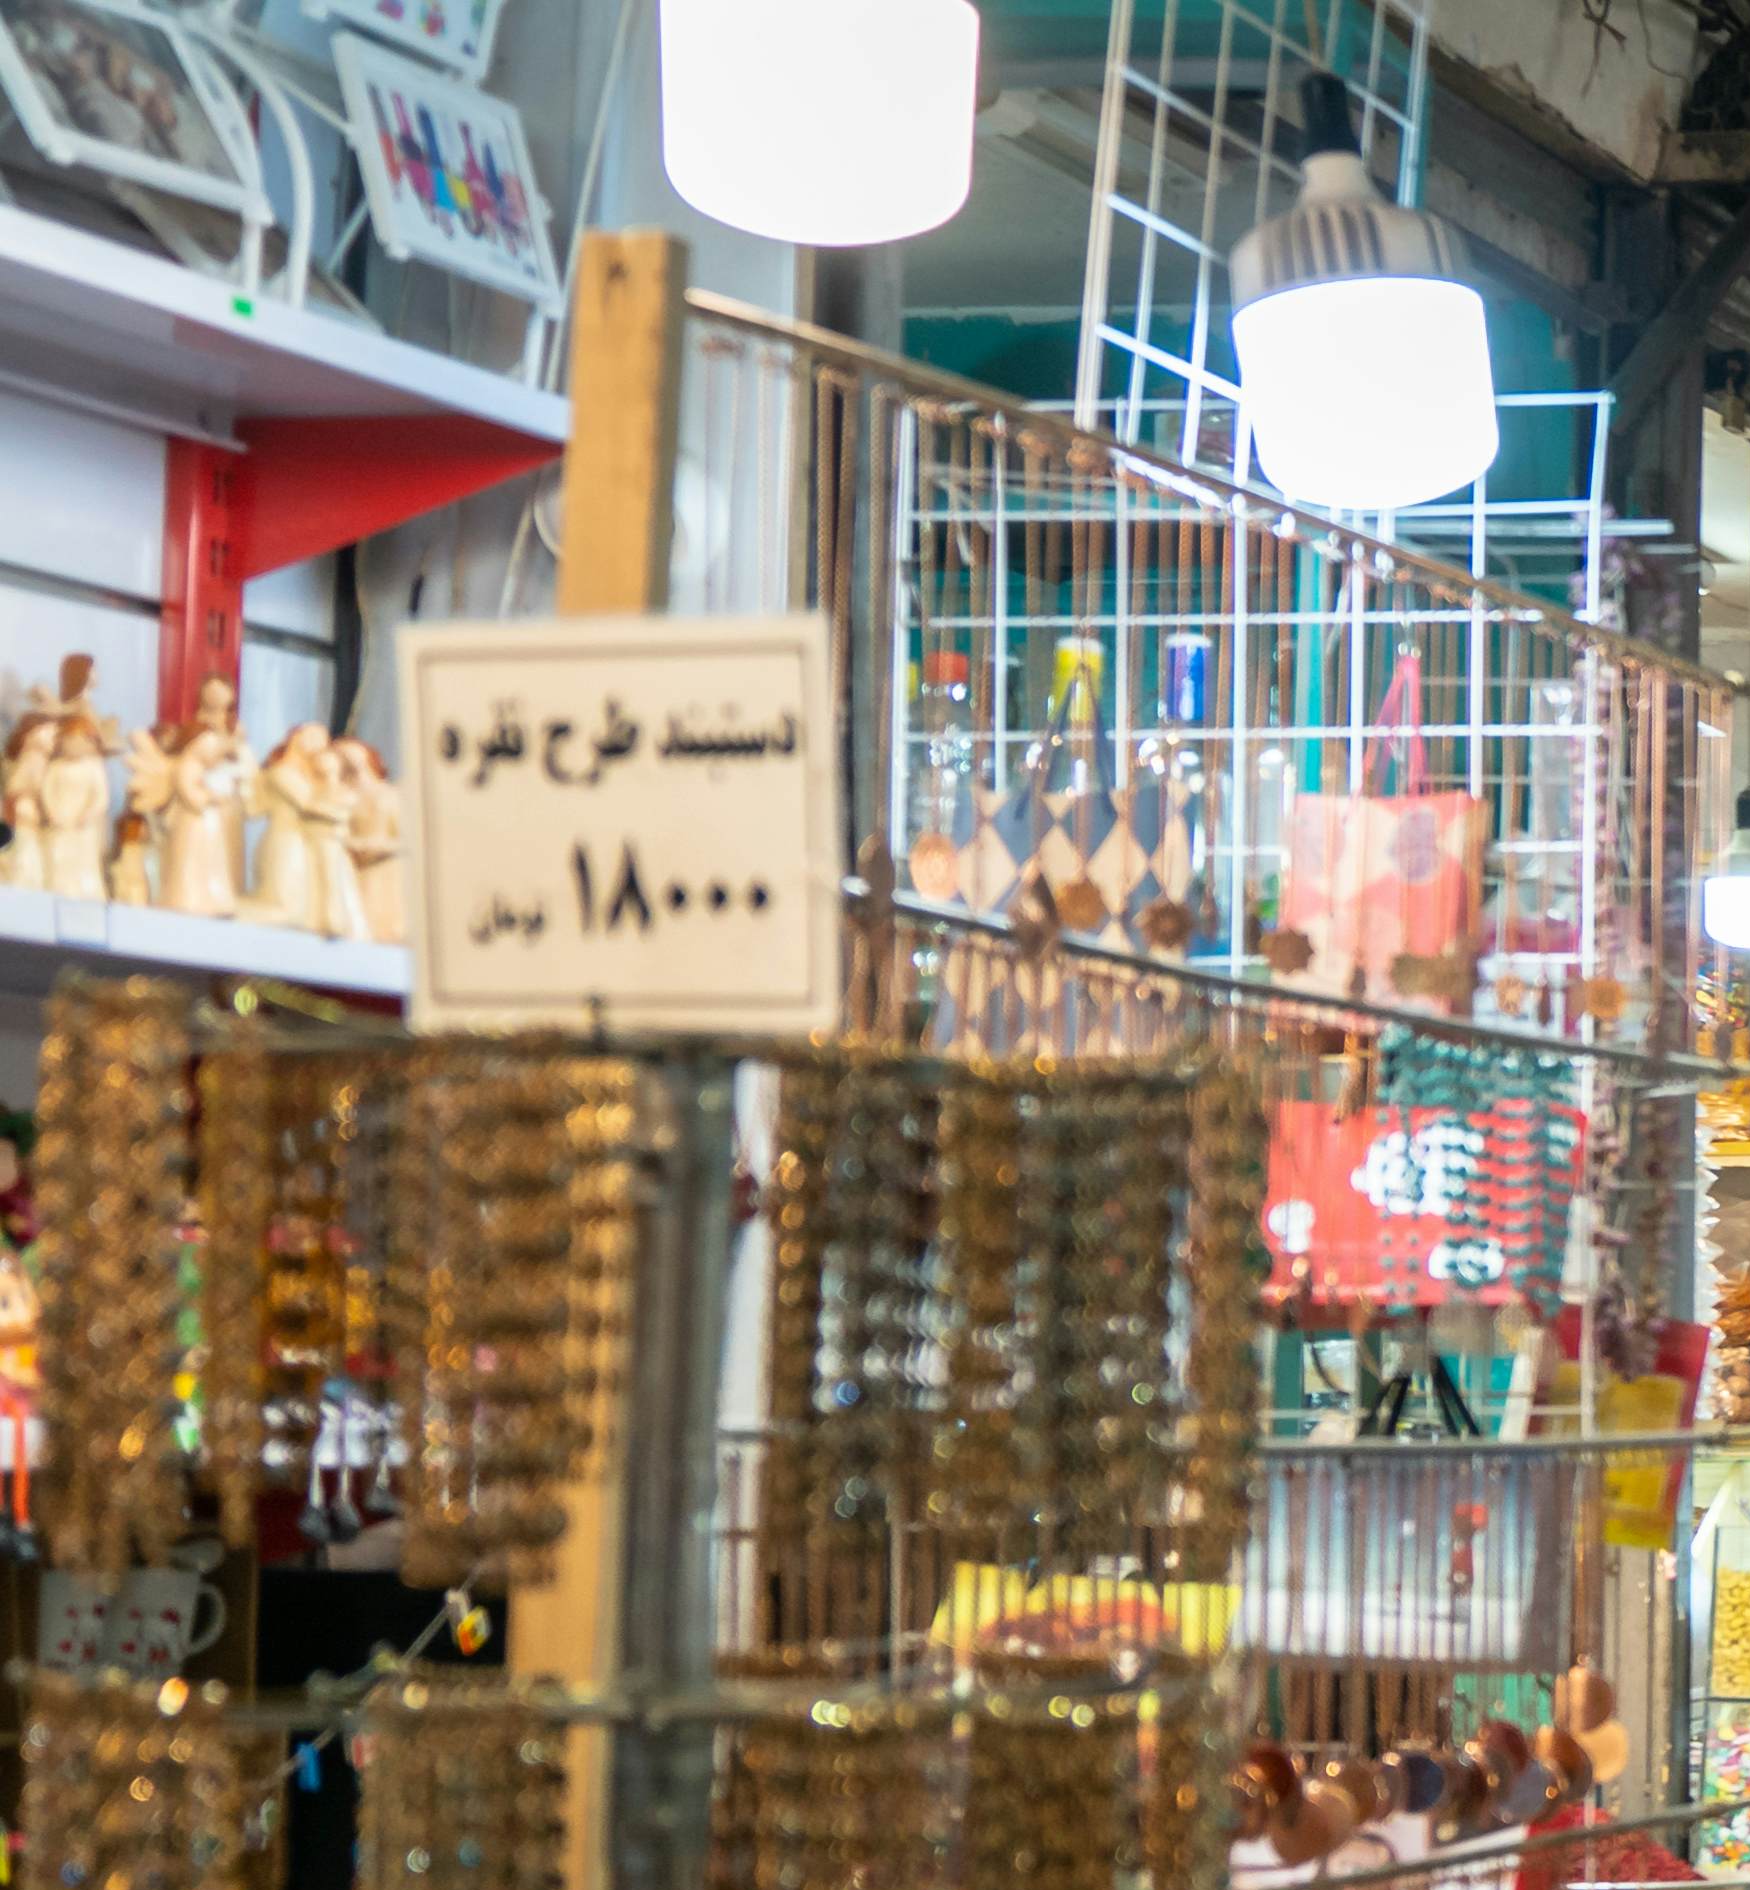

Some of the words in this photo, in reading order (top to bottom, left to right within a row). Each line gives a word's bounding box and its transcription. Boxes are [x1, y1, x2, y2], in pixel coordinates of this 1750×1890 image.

[440, 700, 530, 788] نقره
[543, 702, 644, 787] طرح
[659, 696, 799, 776] دستبند
[571, 836, 771, 936] ۱۸۰۰۰
